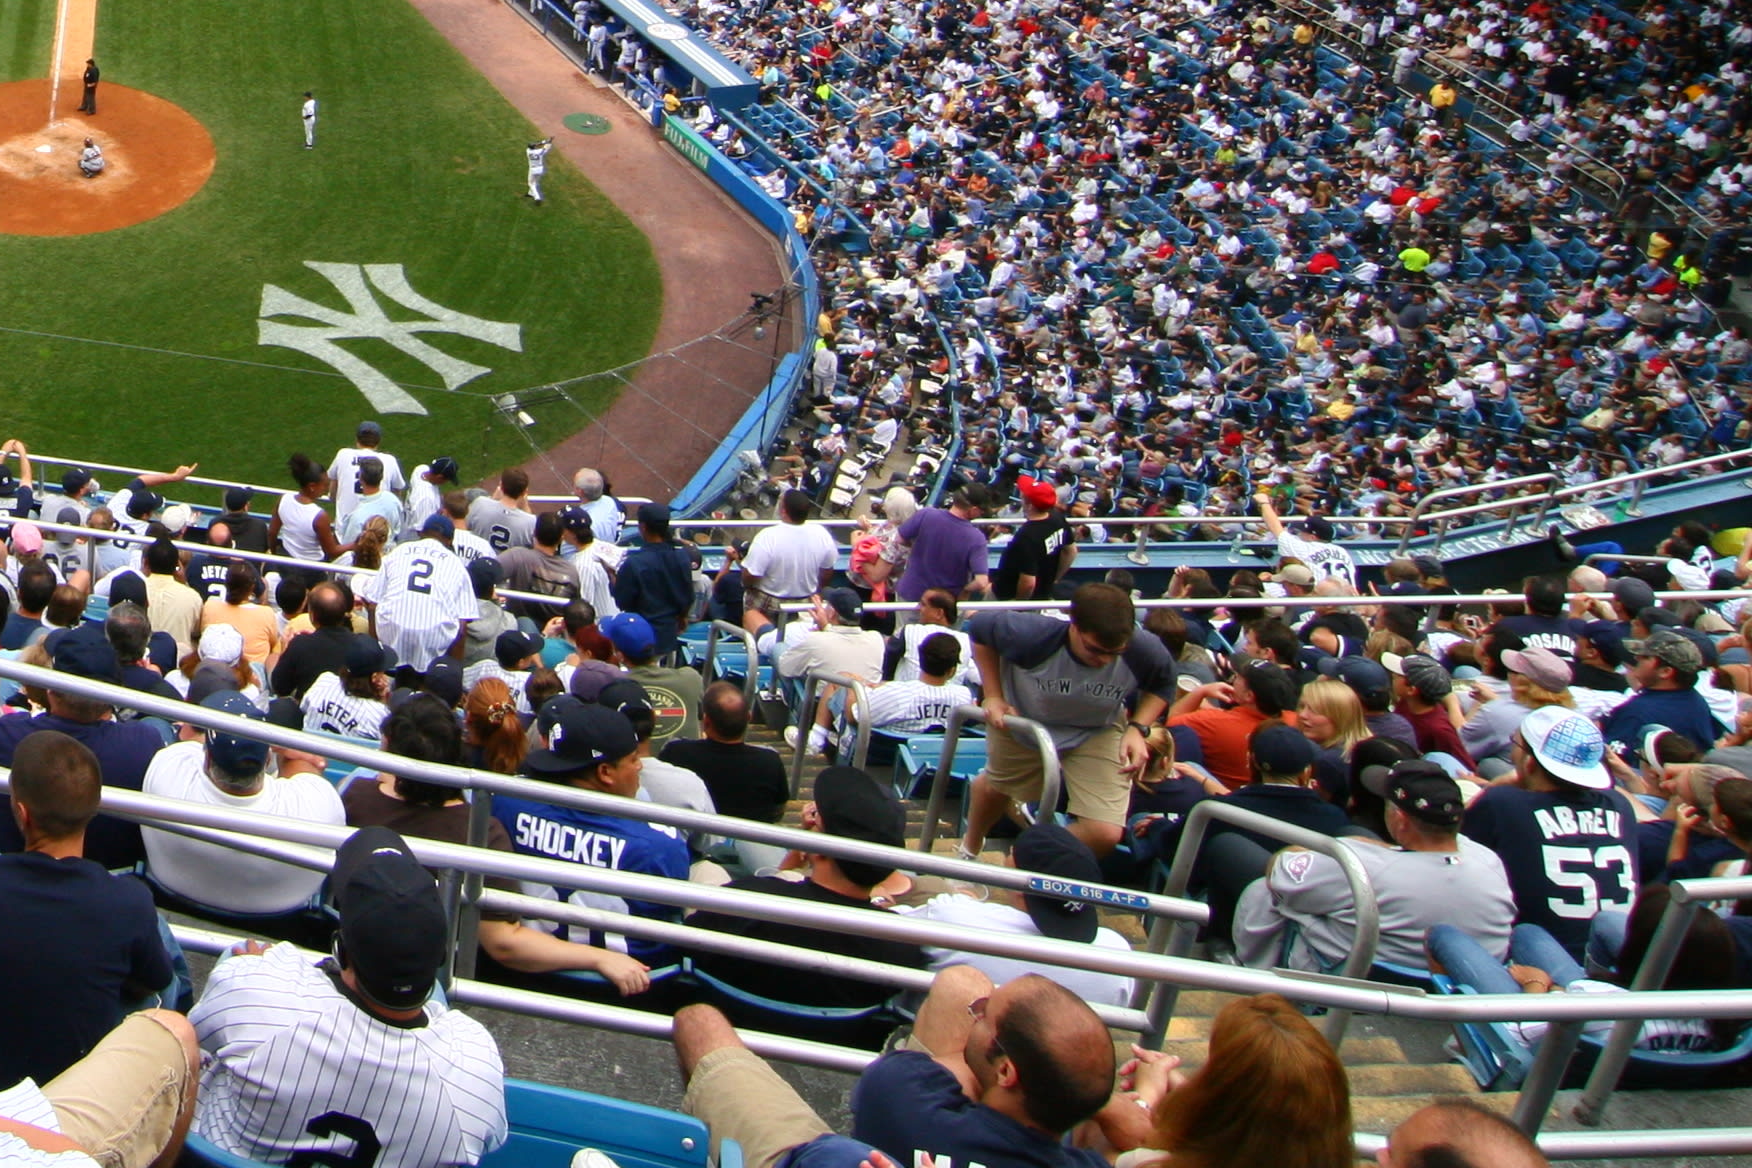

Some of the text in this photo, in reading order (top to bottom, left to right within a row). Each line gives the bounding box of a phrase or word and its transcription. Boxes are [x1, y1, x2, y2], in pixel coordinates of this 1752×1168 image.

[664, 121, 709, 169] FUJIFILM
[257, 259, 524, 417] NY
[404, 545, 449, 561] JETER
[490, 525, 511, 551] 2
[201, 565, 230, 580] JETE
[407, 558, 435, 596] 2
[1036, 678, 1127, 701] NEW YORK
[317, 700, 360, 732] JETER
[915, 703, 952, 721] JETE
[1534, 806, 1622, 840] ABREU
[515, 812, 627, 871] SHOCKEY
[1042, 879, 1137, 905] BOX 616 A-F
[1541, 844, 1637, 919] 53
